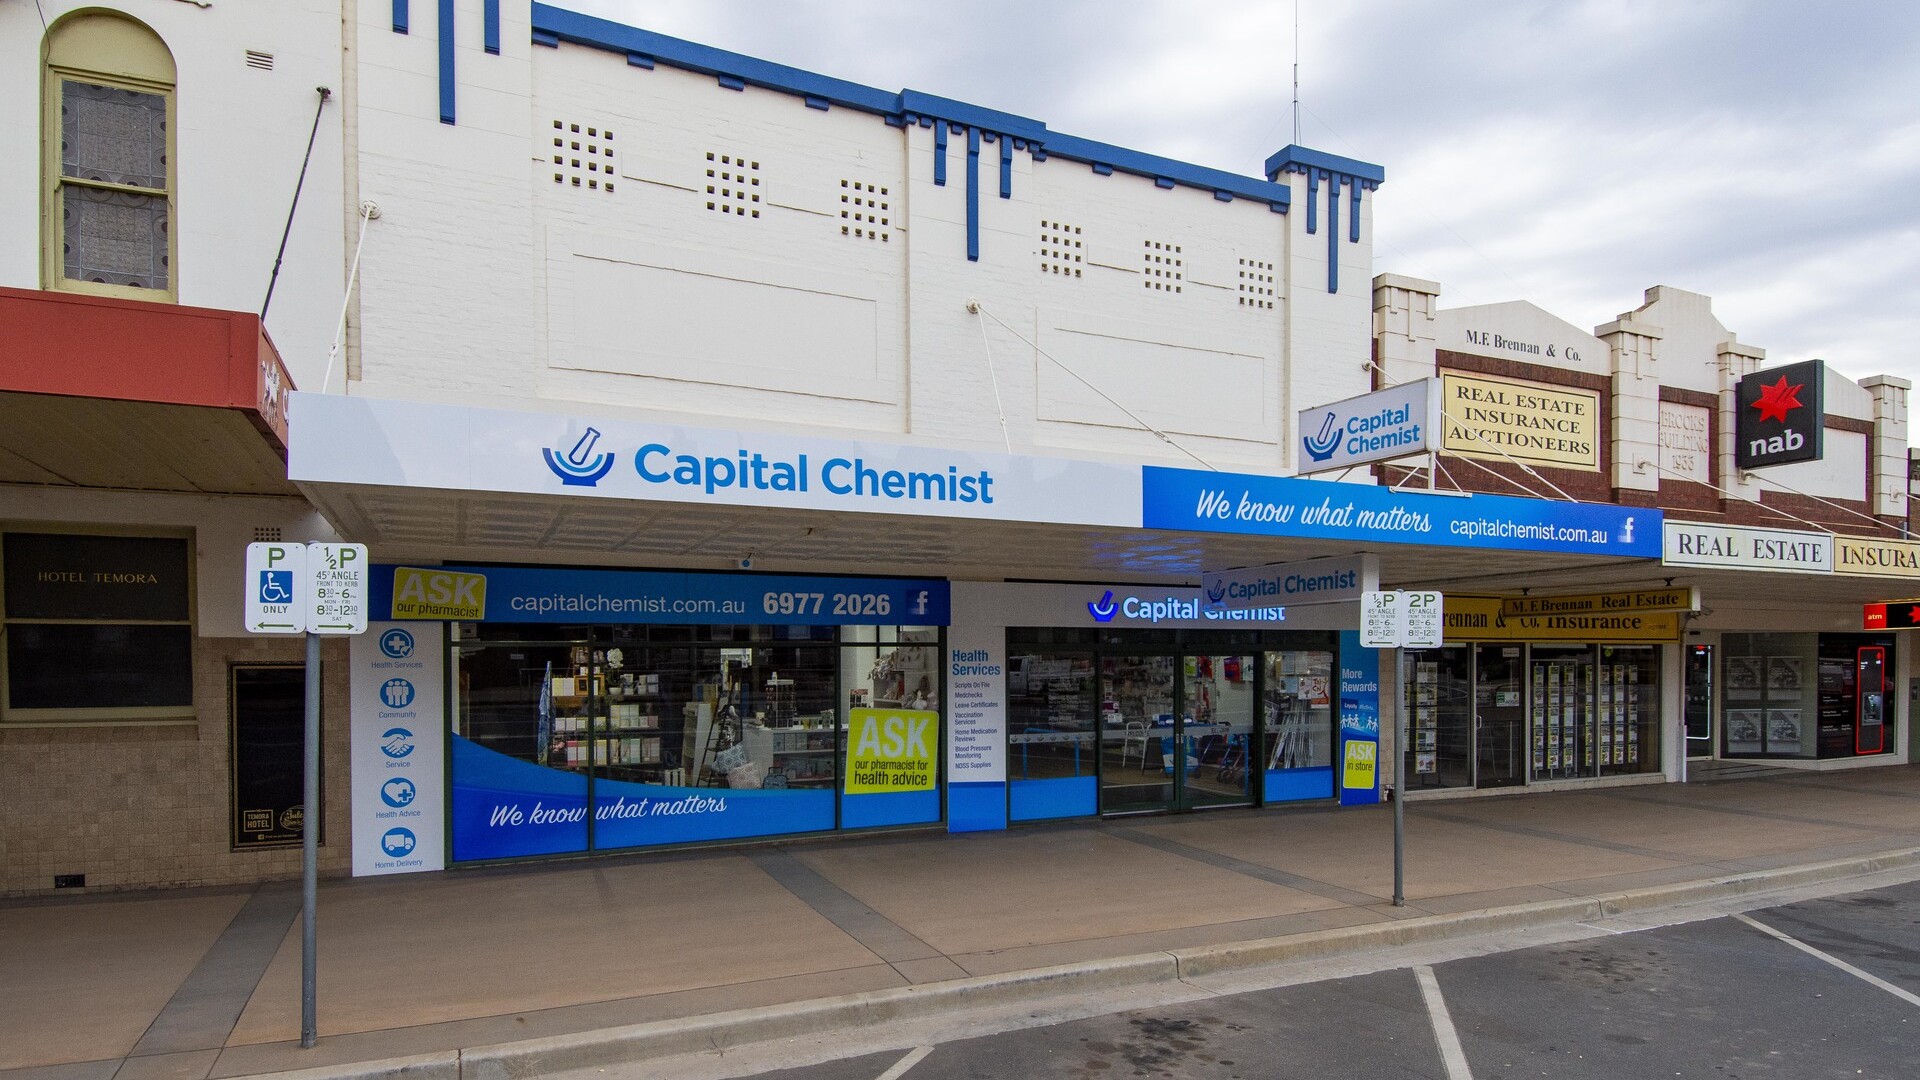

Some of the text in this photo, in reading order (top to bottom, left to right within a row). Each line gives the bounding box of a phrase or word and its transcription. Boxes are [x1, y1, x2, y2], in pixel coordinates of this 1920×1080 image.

[1494, 334, 1540, 355] Brennan
[1546, 343, 1556, 358] &
[1565, 346, 1582, 362] Co.
[1456, 385, 1585, 417] REAL ESTATE
[1346, 403, 1409, 435] Capital
[1464, 407, 1580, 434] INSURANCE
[1660, 410, 1705, 433] BROOKS
[1346, 424, 1420, 455] Chemist
[1449, 426, 1591, 456] AUCTIONEERS
[1750, 428, 1804, 457] nab
[634, 443, 994, 504] Capital Chemist
[1196, 488, 1231, 519] We
[1235, 490, 1295, 523] know
[1300, 496, 1353, 527] what
[1356, 505, 1432, 532] matters
[1450, 517, 1608, 544] capitalchemist.com.au
[268, 547, 286, 569] P
[1678, 533, 1822, 563] REAL ESTATE
[1841, 545, 1919, 569] INSURA
[38, 571, 158, 584] HOTEL TEMORA
[331, 571, 359, 581] ANGLE
[1228, 570, 1356, 600] Capital Chemist
[398, 573, 478, 606] ASK
[263, 606, 288, 614] ONLY
[396, 601, 479, 618] our pharmacist
[510, 593, 745, 615] capitalchemist.com.au
[763, 592, 825, 615] 6977
[832, 593, 891, 616] 2026
[1122, 597, 1199, 622] Capital
[1541, 599, 1593, 612] Brennan
[1601, 595, 1630, 609] Real
[1636, 593, 1679, 607] Estate
[1443, 612, 1488, 628] rennan
[1495, 608, 1506, 628] &
[1546, 616, 1642, 629] Insurance
[952, 650, 988, 662] Health
[952, 664, 1000, 676] Services
[1342, 669, 1362, 679] More
[1342, 682, 1377, 692] Rewards
[379, 711, 417, 719] Community
[856, 716, 929, 758] ASK
[955, 752, 981, 760] Monitoring
[1348, 743, 1374, 760] ASK
[855, 760, 928, 771] our pharmacist for
[1347, 761, 1373, 771] in store
[854, 771, 928, 785] health advice
[489, 794, 728, 827] We know what matters
[247, 820, 270, 828] HOTEL
[375, 860, 423, 869] Home Delivery
